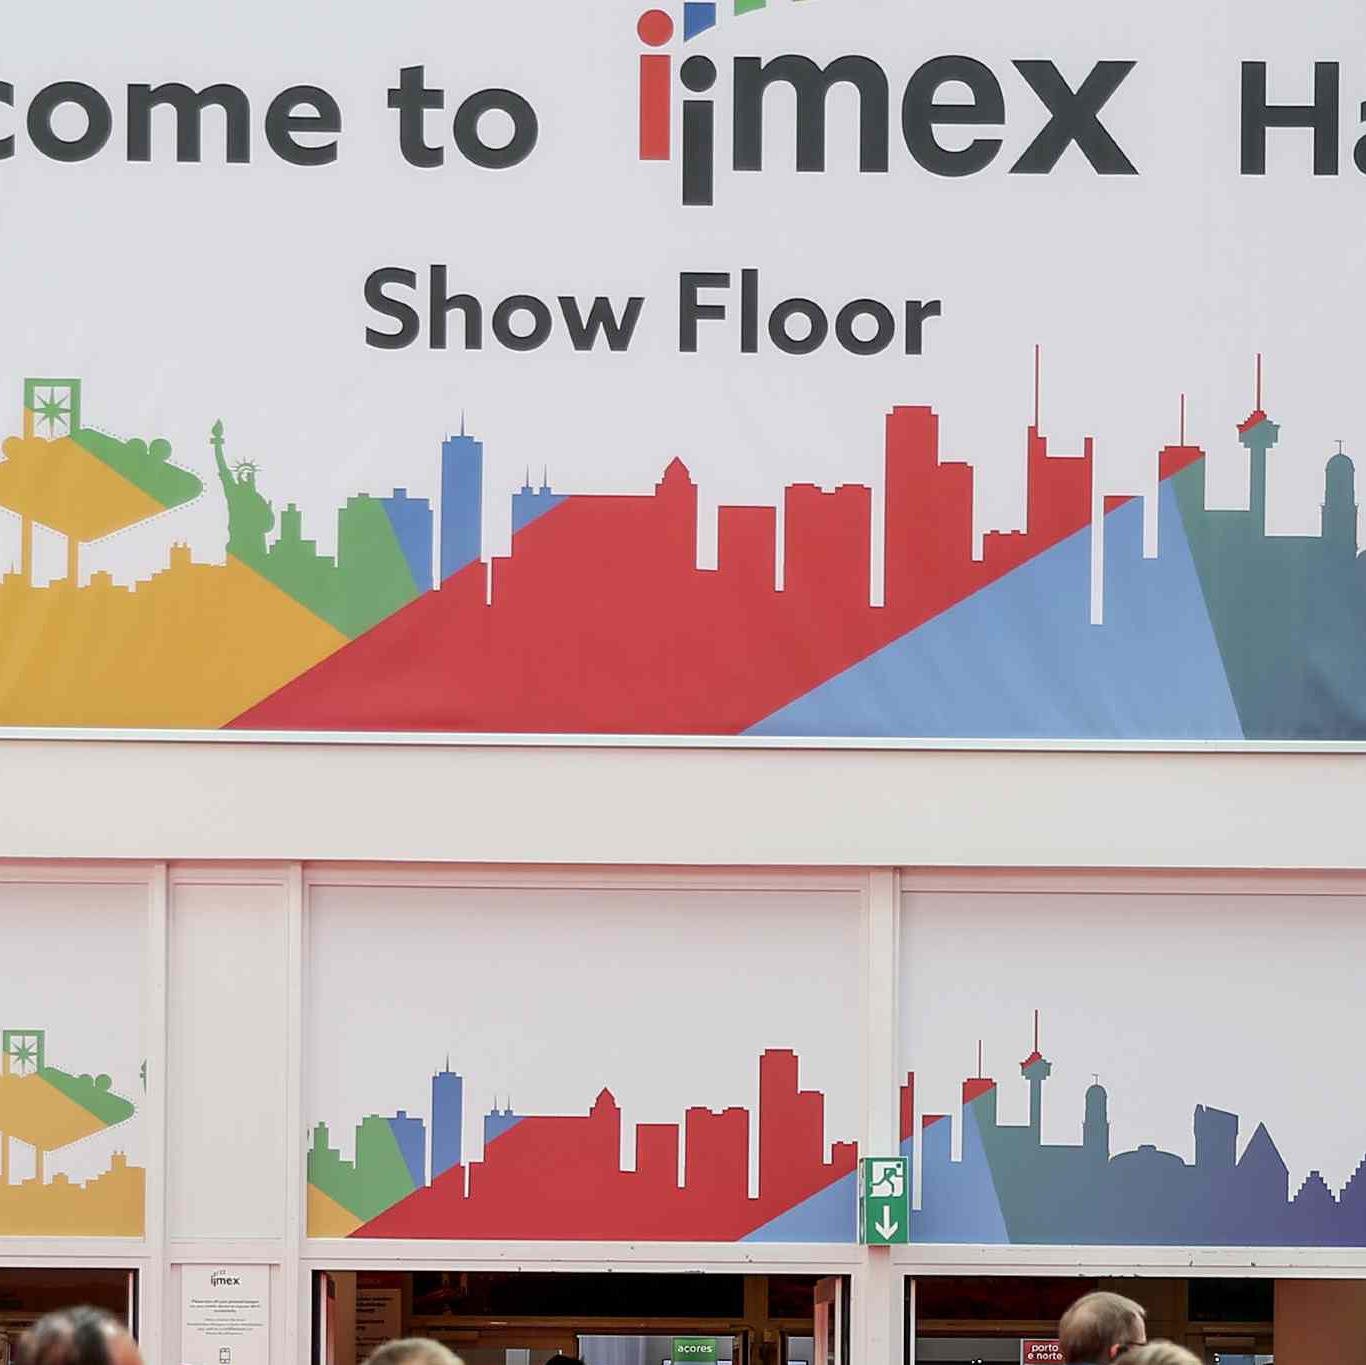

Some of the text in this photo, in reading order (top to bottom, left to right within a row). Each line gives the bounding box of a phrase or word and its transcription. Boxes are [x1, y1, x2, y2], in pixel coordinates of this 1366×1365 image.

[387, 65, 539, 170] to
[362, 265, 942, 356] Show Floor
[1031, 1343, 1059, 1353] porto
[1036, 1352, 1063, 1361] norte
